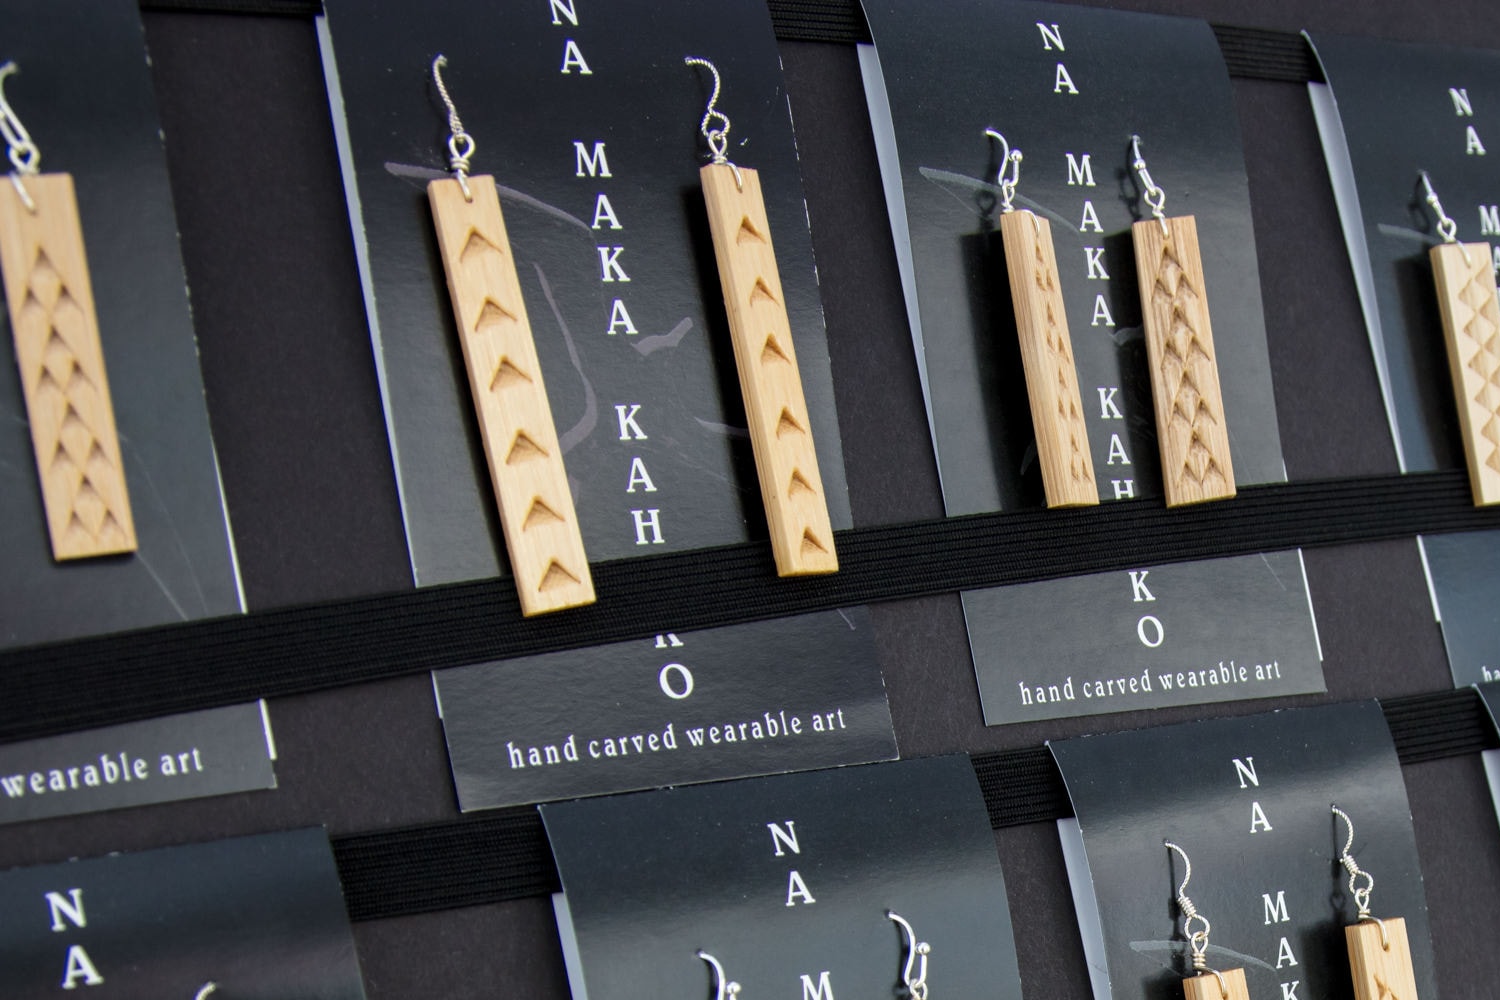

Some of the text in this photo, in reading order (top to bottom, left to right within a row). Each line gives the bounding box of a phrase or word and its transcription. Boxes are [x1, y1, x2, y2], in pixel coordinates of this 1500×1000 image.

[1448, 88, 1487, 155] NA
[1036, 22, 1079, 94] NA
[1065, 153, 1115, 327] MAKA
[573, 142, 638, 334] MAKA
[1018, 659, 1282, 705] hand carved wearable art
[0, 747, 204, 798] wearable art
[506, 707, 847, 769] hand carved wearable art
[1232, 756, 1273, 834] NA
[766, 820, 817, 907] NA
[44, 888, 103, 990] NA
